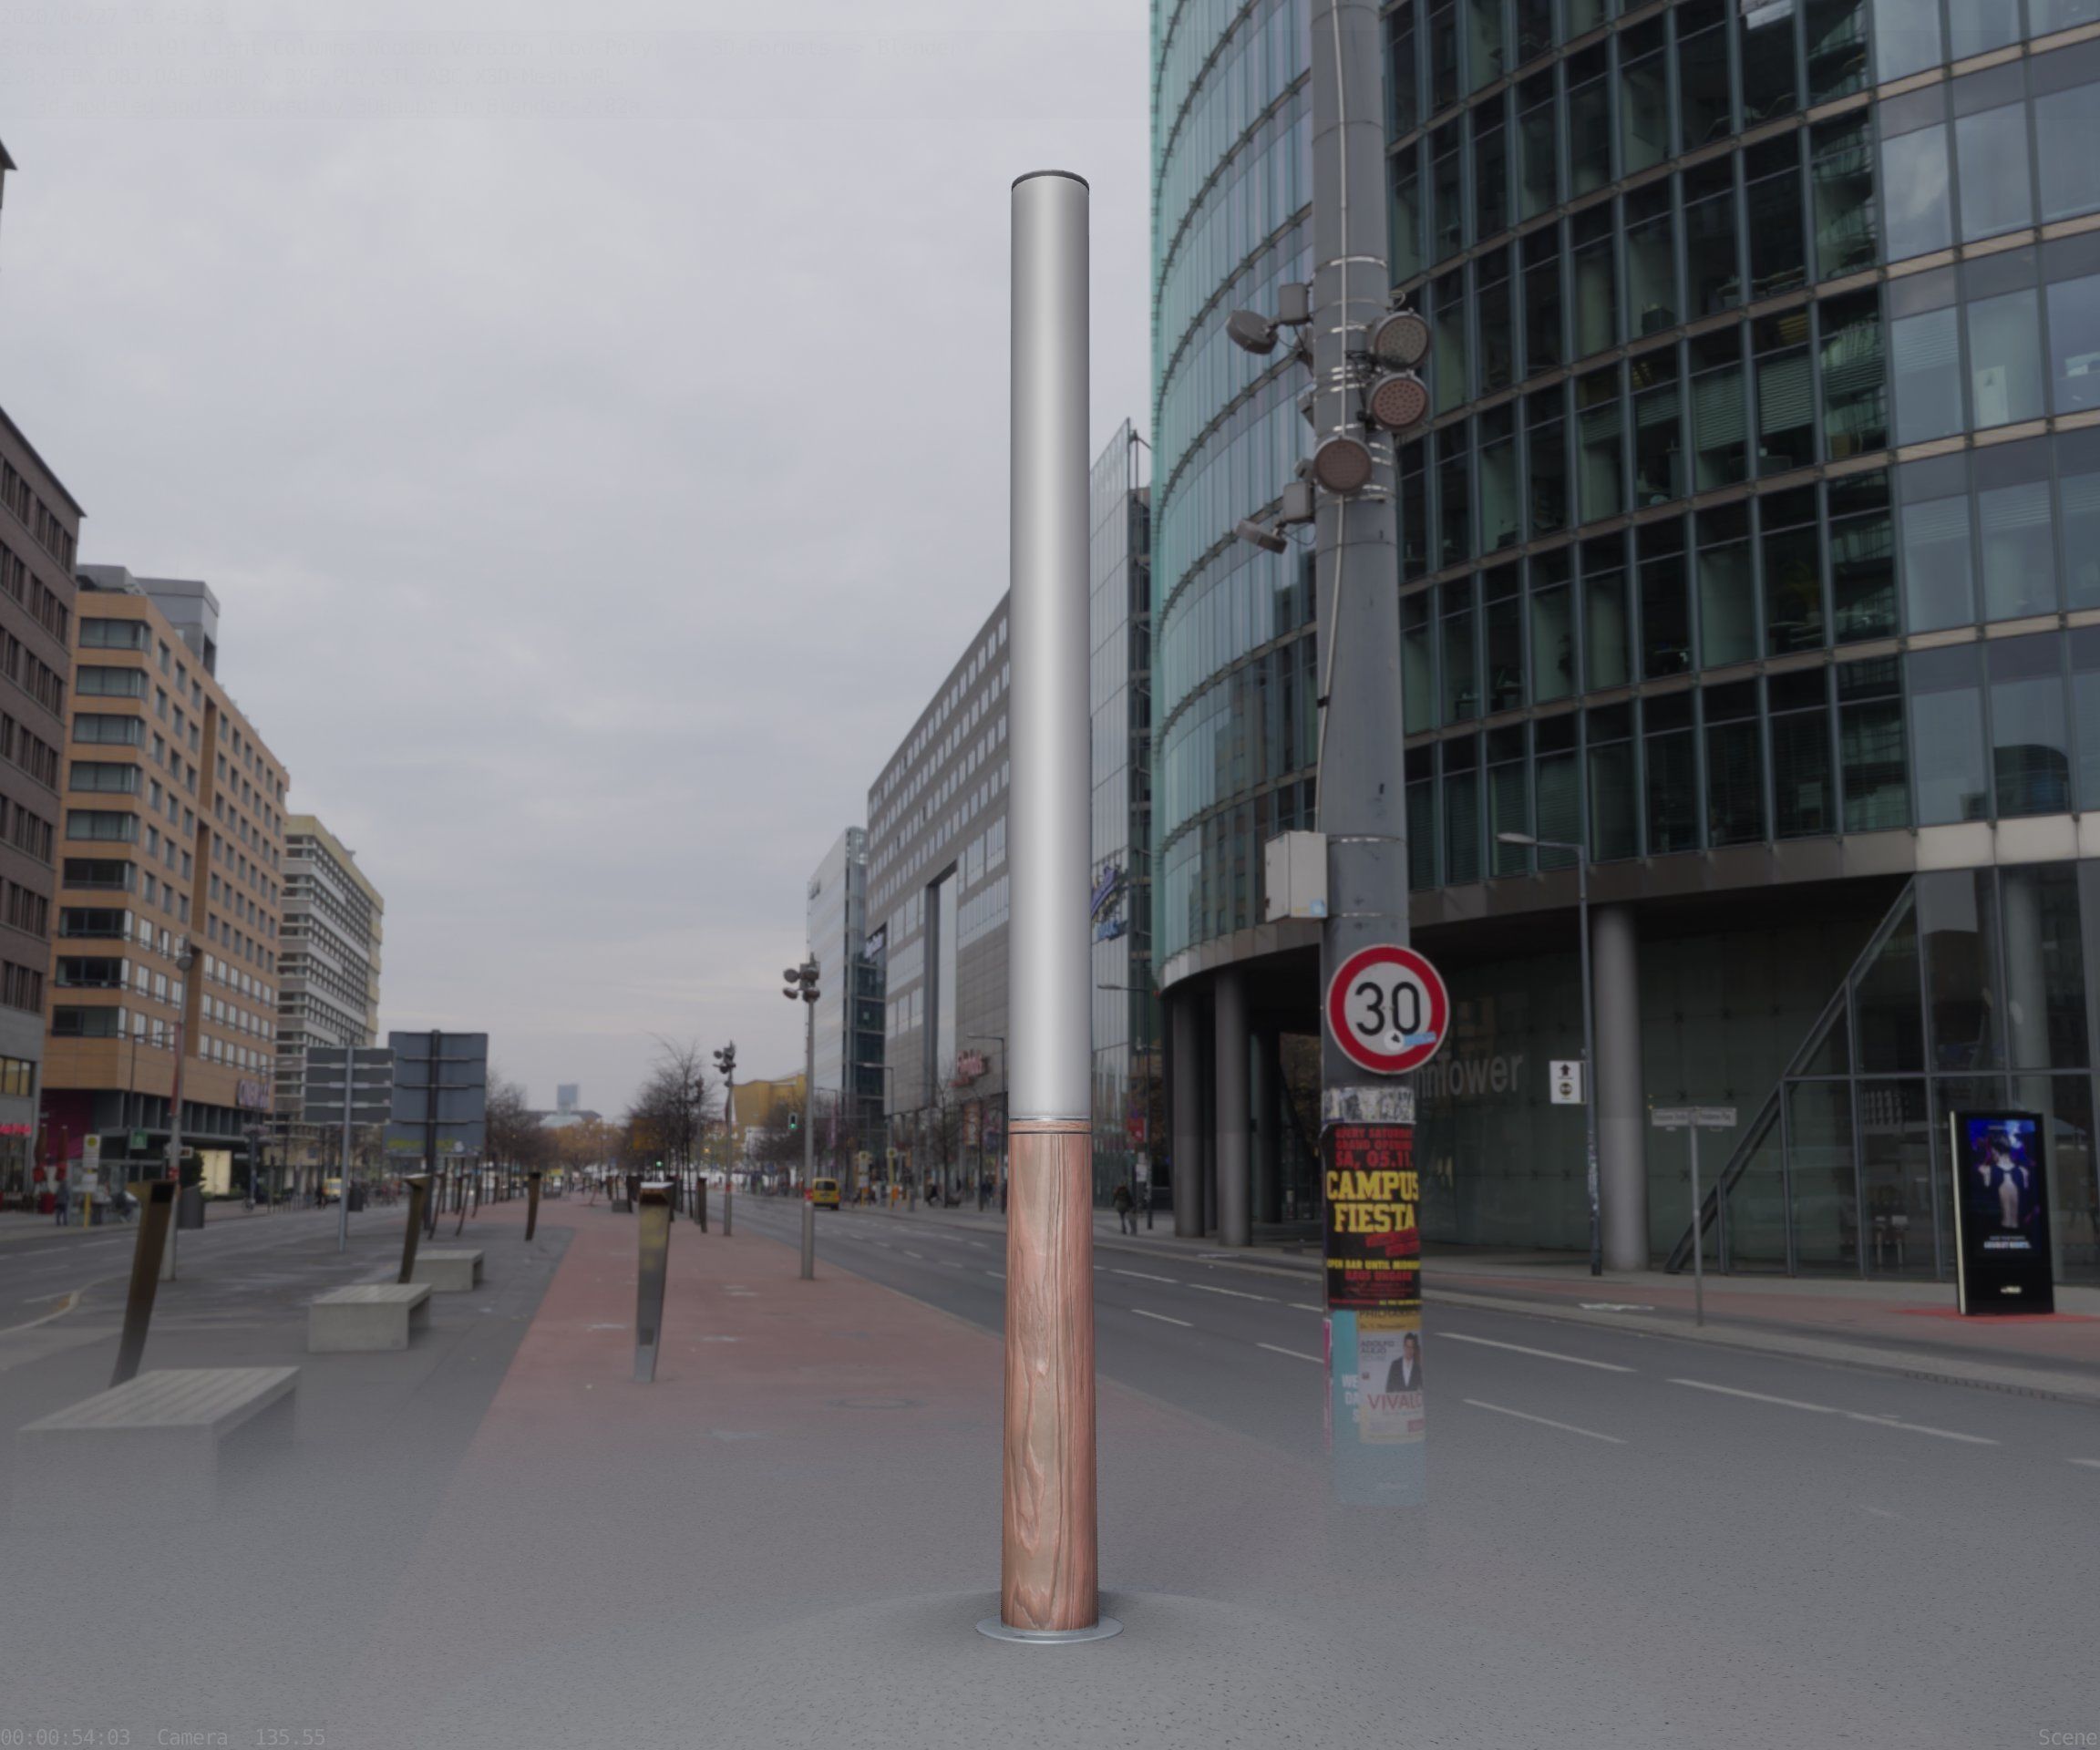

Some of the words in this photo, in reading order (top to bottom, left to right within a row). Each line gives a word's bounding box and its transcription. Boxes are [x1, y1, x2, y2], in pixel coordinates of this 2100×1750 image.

[1355, 982, 1421, 1035] 30
[1326, 1170, 1419, 1201] CAMPUS
[1333, 1203, 1415, 1233] FIESTA
